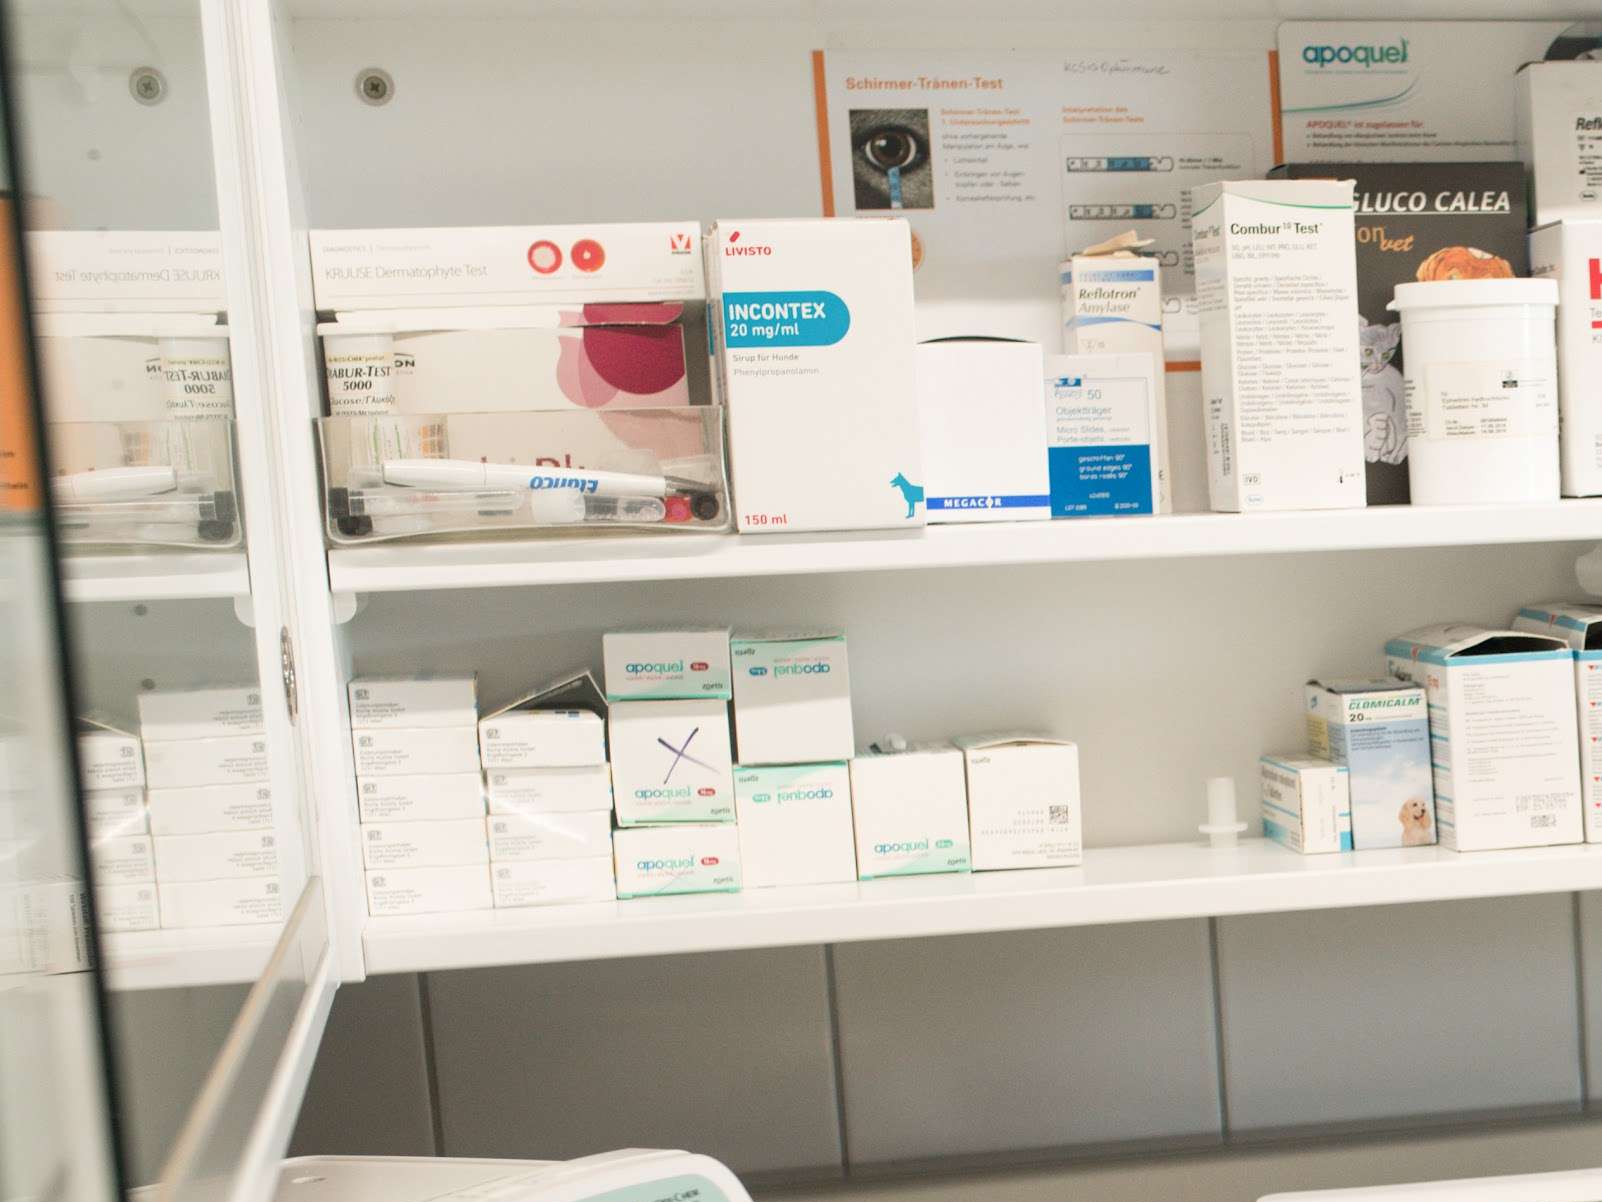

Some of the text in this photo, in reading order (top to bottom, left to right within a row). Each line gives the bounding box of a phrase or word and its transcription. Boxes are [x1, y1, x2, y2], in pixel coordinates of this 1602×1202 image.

[1302, 37, 1409, 68] apoquel
[846, 74, 1004, 91] Schirmer-Tränen-Test
[1434, 191, 1511, 212] CALEA
[1230, 222, 1280, 235] Combur
[1295, 222, 1319, 235] Test
[1381, 235, 1414, 251] vet
[725, 246, 772, 257] LIVISTO
[325, 265, 488, 281] KRUUSE Dermatophyte Test
[728, 302, 826, 321] INCONTEX
[1078, 302, 1130, 314] Amylase
[730, 322, 799, 339] 20 mg/ml
[733, 352, 799, 363] Sirup für Hunde
[343, 381, 372, 391] 5000
[1087, 389, 1102, 400] 50
[944, 496, 1002, 508] MEGACOR
[744, 513, 787, 526] 150 ml
[626, 660, 683, 675] apoquel
[774, 662, 831, 678] apoquel
[1349, 697, 1420, 711] CLOMICALM
[1350, 712, 1364, 722] 20
[635, 786, 691, 799] apoquel
[777, 788, 833, 804] apoquel
[874, 838, 928, 854] apoquel
[637, 856, 694, 871] apoquel
